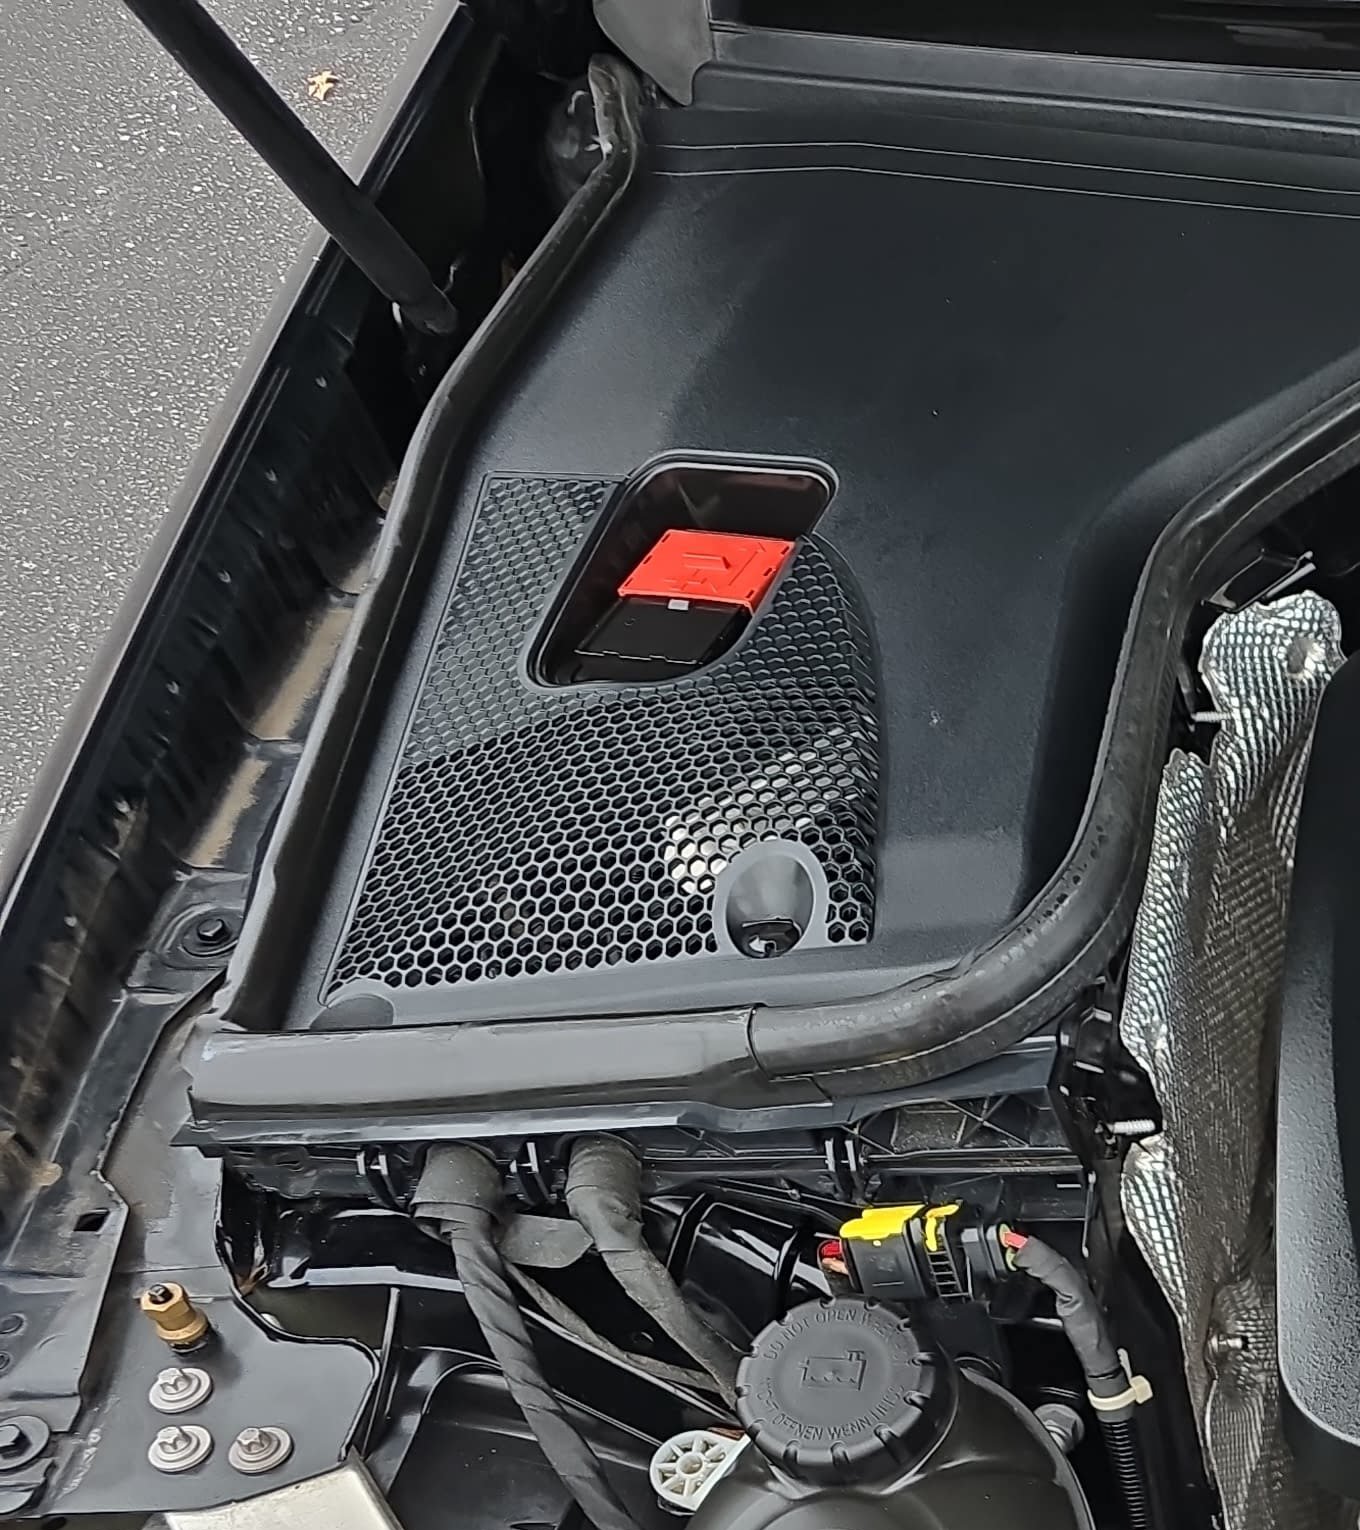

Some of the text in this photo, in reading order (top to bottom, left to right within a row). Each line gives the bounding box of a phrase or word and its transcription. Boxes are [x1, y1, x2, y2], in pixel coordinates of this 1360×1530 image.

[783, 1318, 809, 1340] NOT
[816, 1309, 857, 1323] OPEN
[827, 1415, 872, 1441] WENN
